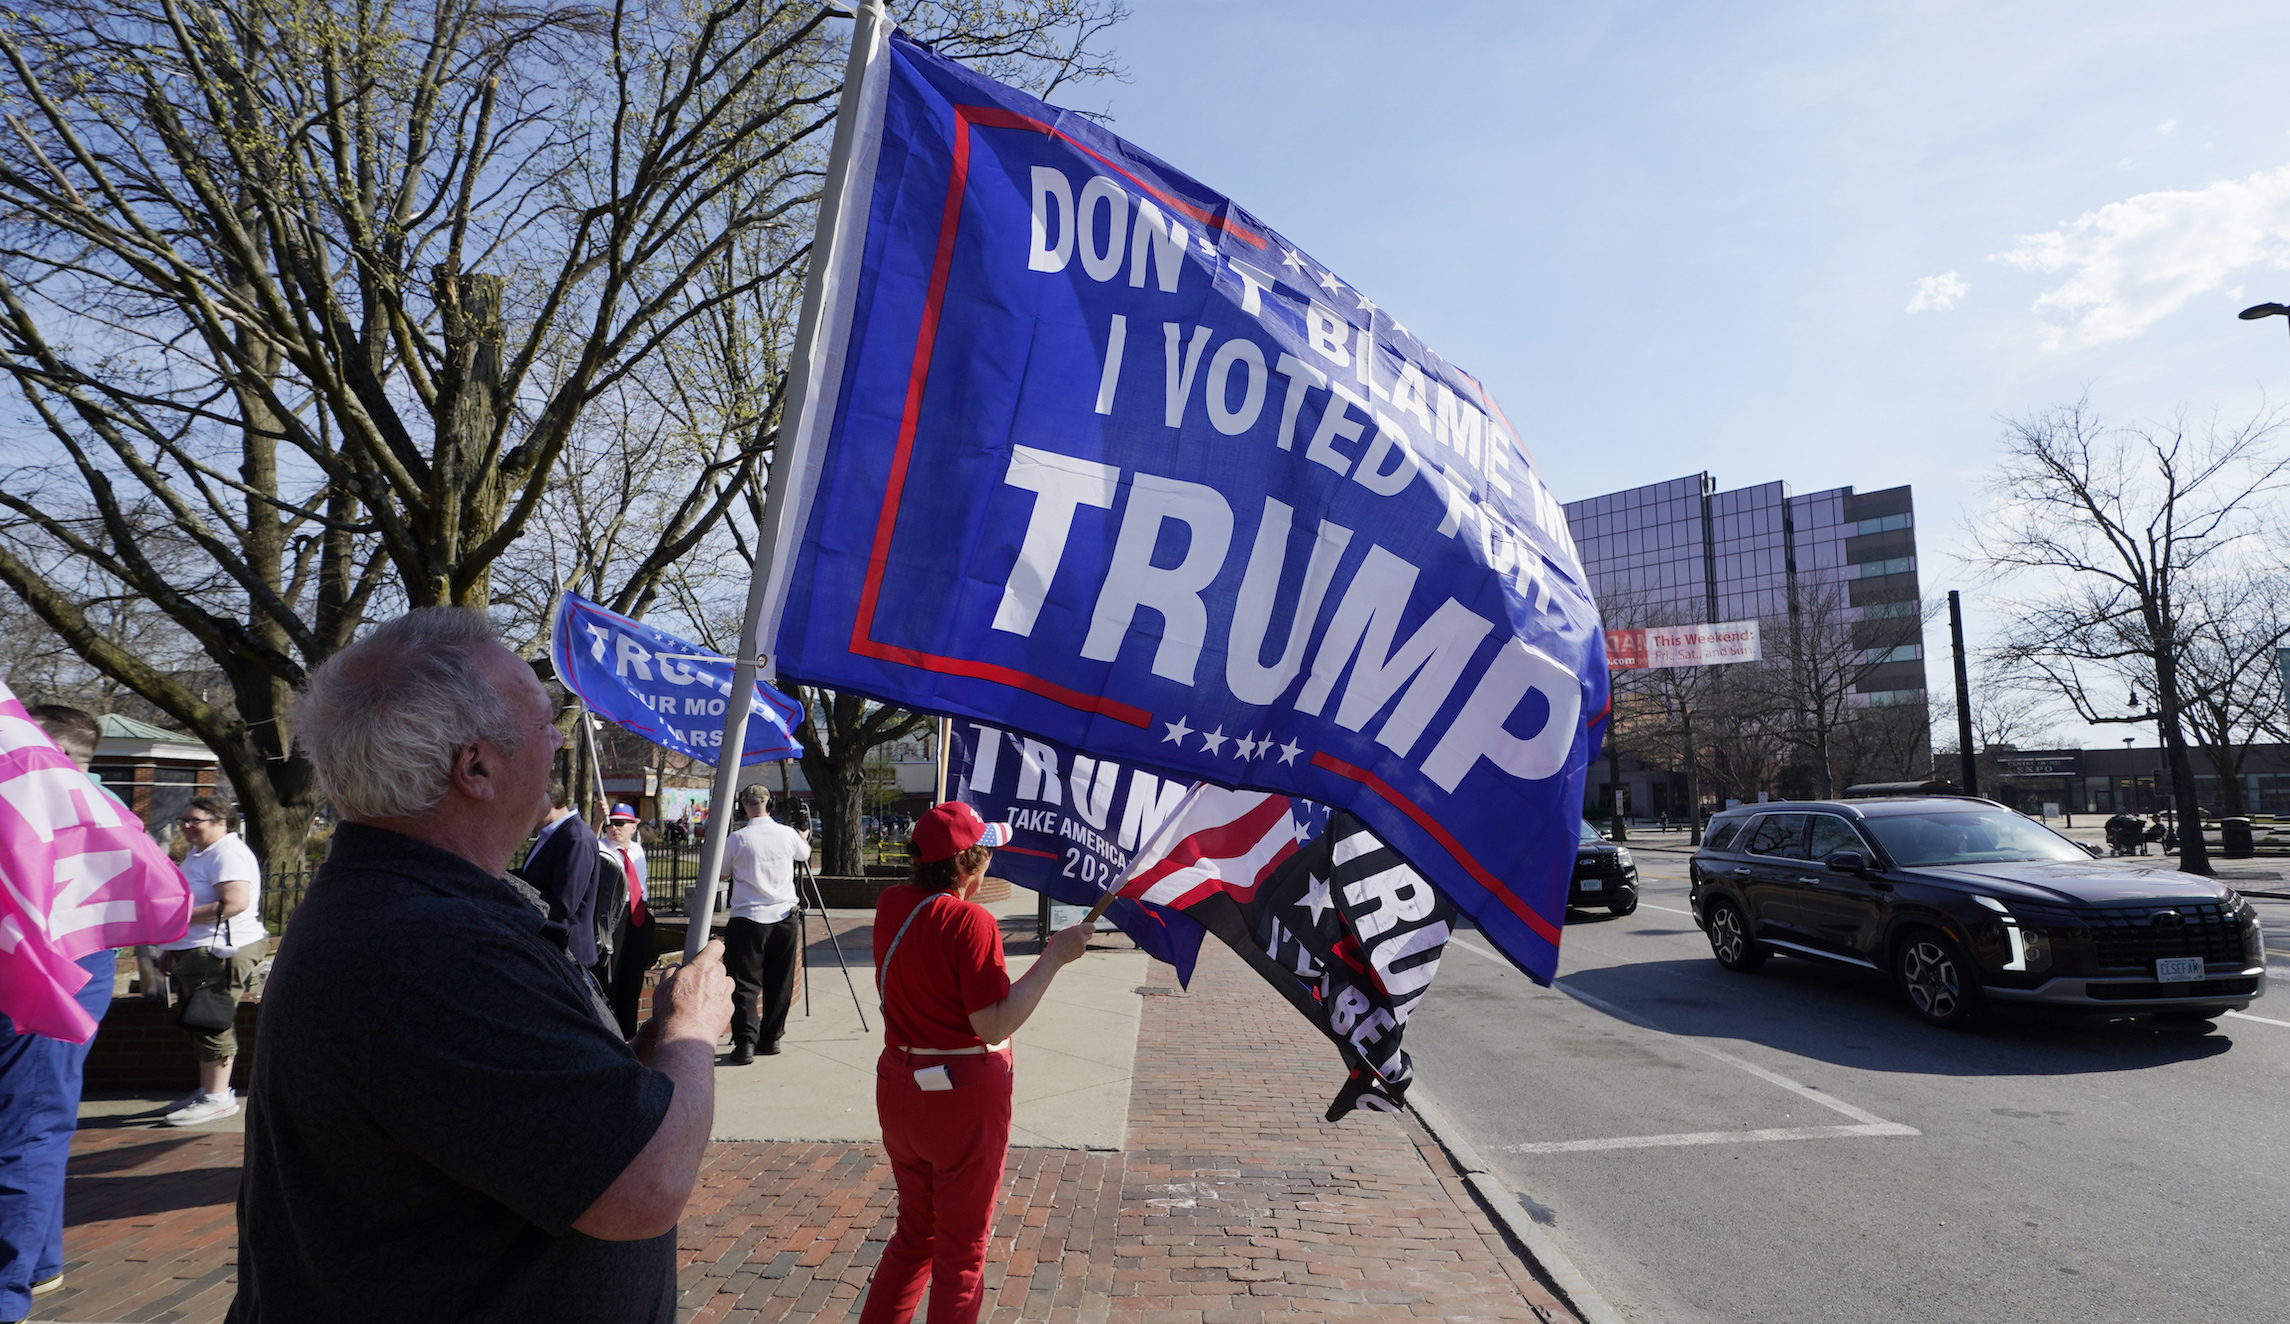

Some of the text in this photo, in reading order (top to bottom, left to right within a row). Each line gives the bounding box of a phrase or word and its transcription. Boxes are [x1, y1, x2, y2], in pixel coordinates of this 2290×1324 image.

[1306, 298, 1512, 499] BLAME
[1094, 313, 1550, 616] I VOTED FOR
[991, 443, 1582, 794] TRUMP
[1652, 630, 1754, 647] This Weekend:
[1706, 647, 1727, 657] and
[969, 723, 1188, 851] TRUM
[1006, 806, 1127, 871] TAKE AMERICA
